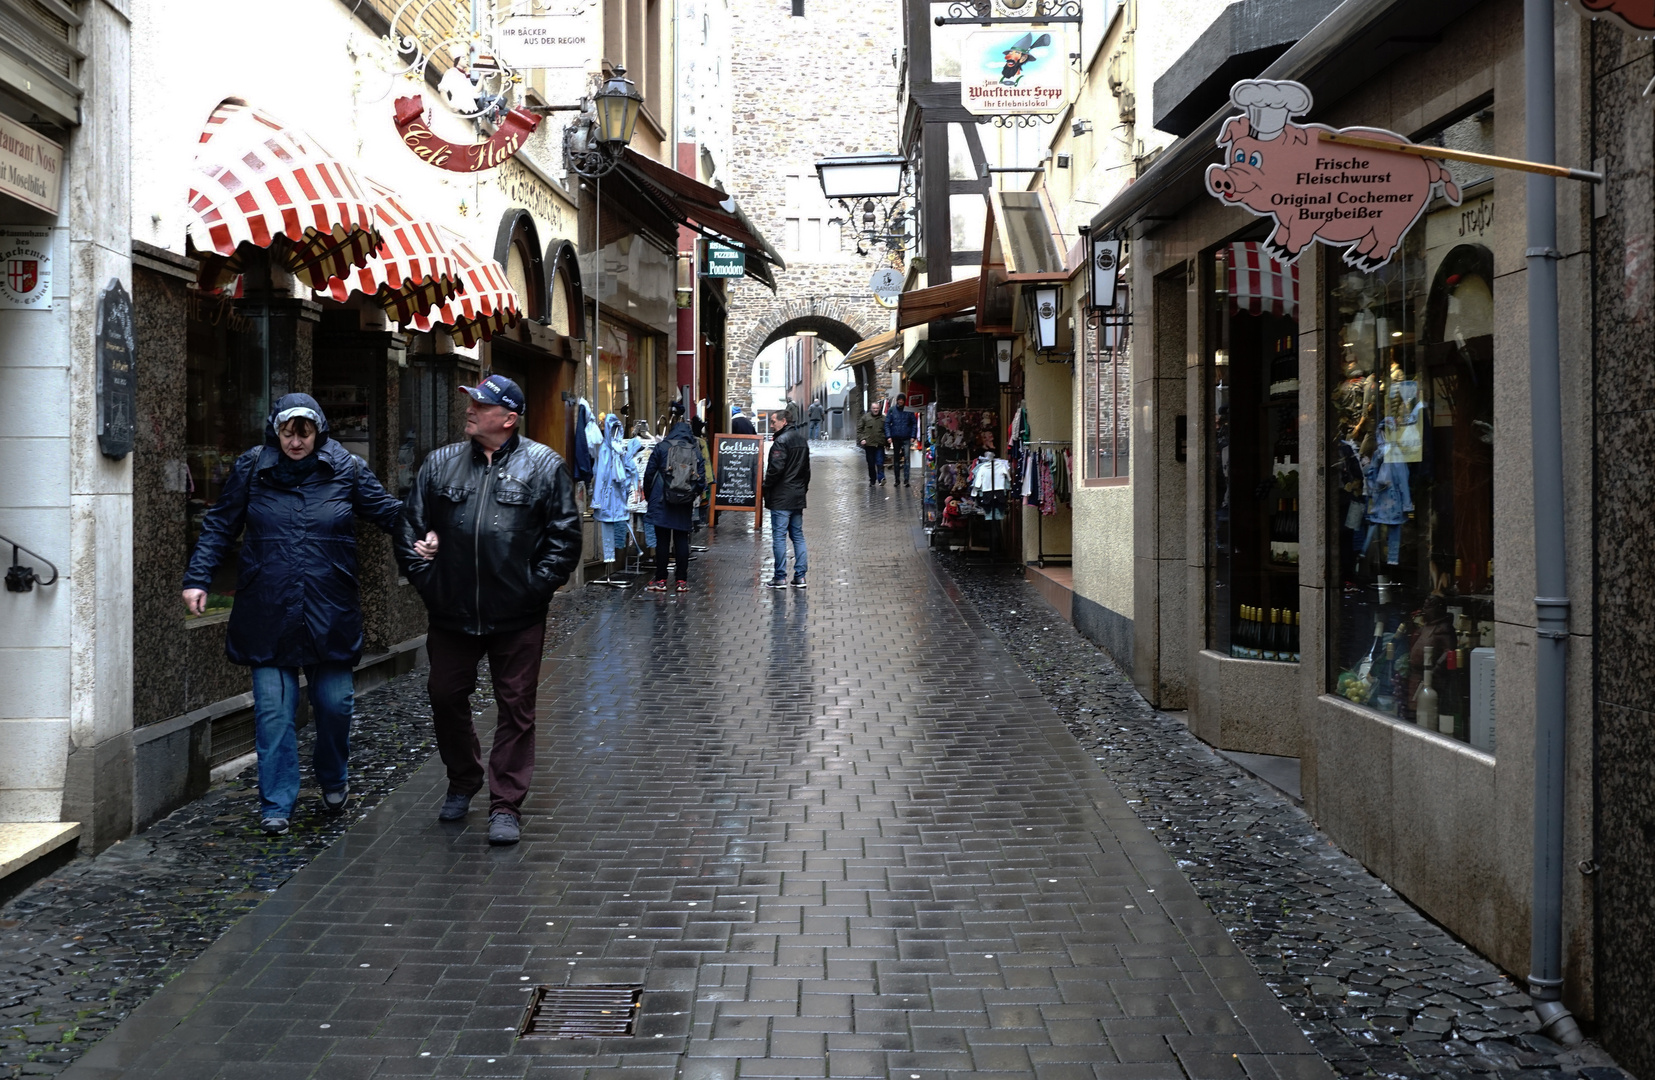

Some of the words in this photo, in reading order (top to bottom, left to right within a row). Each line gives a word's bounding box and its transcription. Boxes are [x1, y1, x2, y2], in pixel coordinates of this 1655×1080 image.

[518, 26, 547, 36] BÄCKER
[524, 37, 539, 45] AUS
[541, 37, 556, 45] DER
[558, 36, 586, 44] REGION
[1034, 86, 1062, 99] Sepp
[403, 123, 453, 167] Café
[467, 132, 519, 171] Flair
[35, 143, 56, 174] Noss
[1315, 157, 1370, 170] Frische
[8, 164, 47, 198] Moselblick
[1296, 172, 1392, 185] Fleischwurst
[1271, 192, 1332, 207] Original
[1337, 191, 1414, 204] Cochemer
[709, 260, 744, 275] Pomodoro
[719, 441, 759, 452] Cocktails
